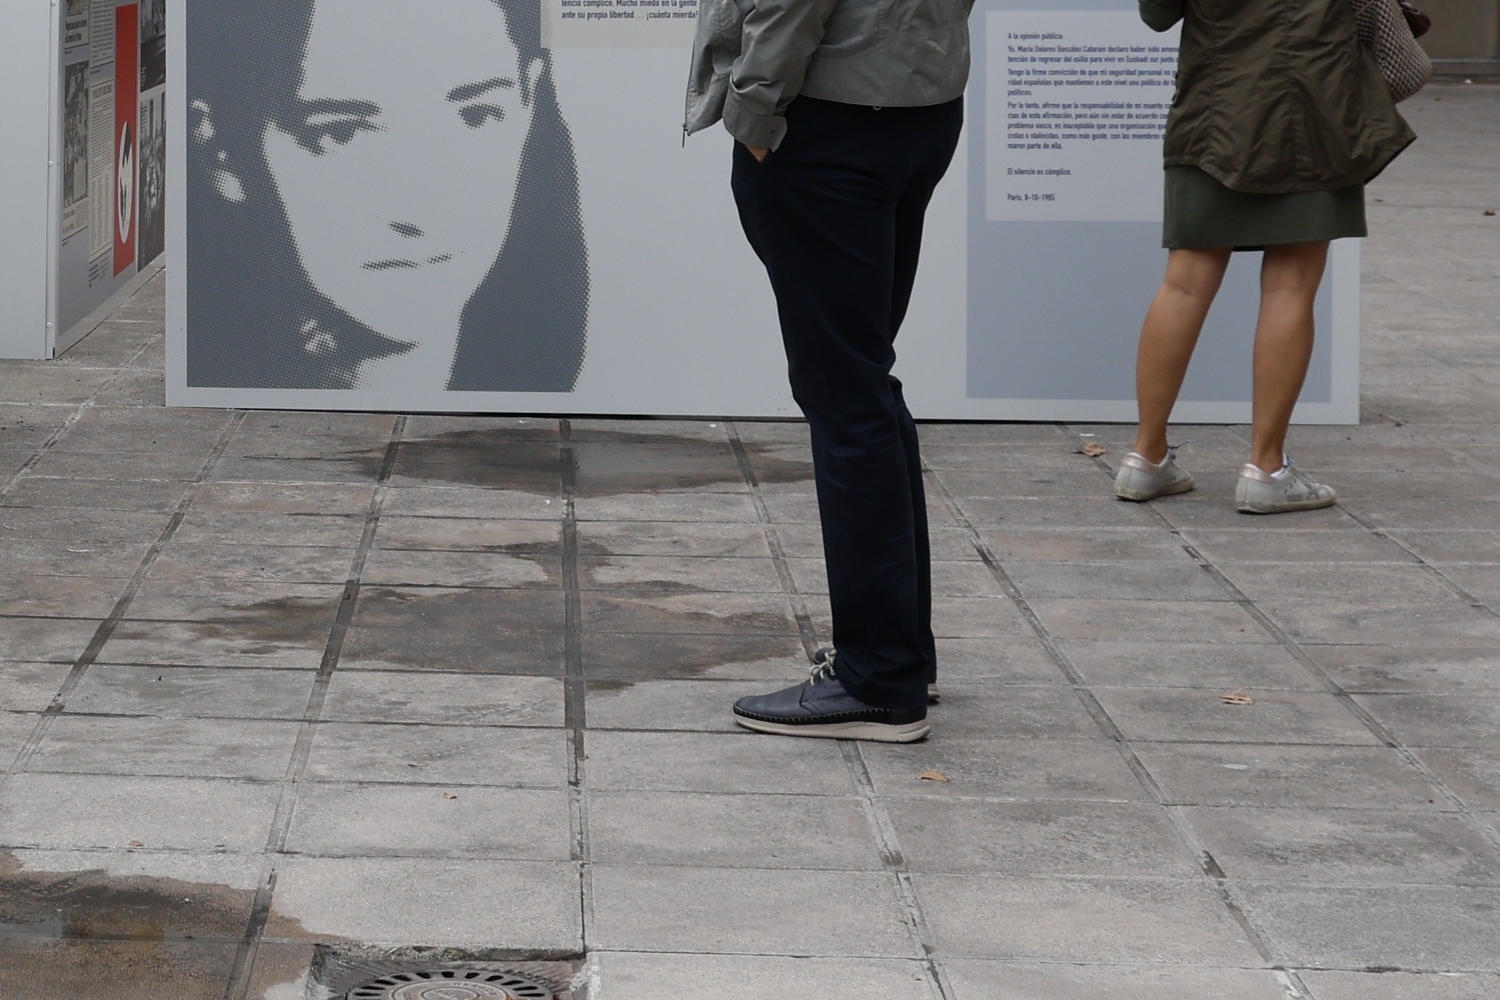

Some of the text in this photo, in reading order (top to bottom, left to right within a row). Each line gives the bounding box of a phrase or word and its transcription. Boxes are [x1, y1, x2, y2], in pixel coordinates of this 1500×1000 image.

[561, 11, 576, 19] ante
[587, 11, 608, 21] propia
[646, 11, 671, 21] ¡cuánta
[672, 10, 699, 20] mierda!
